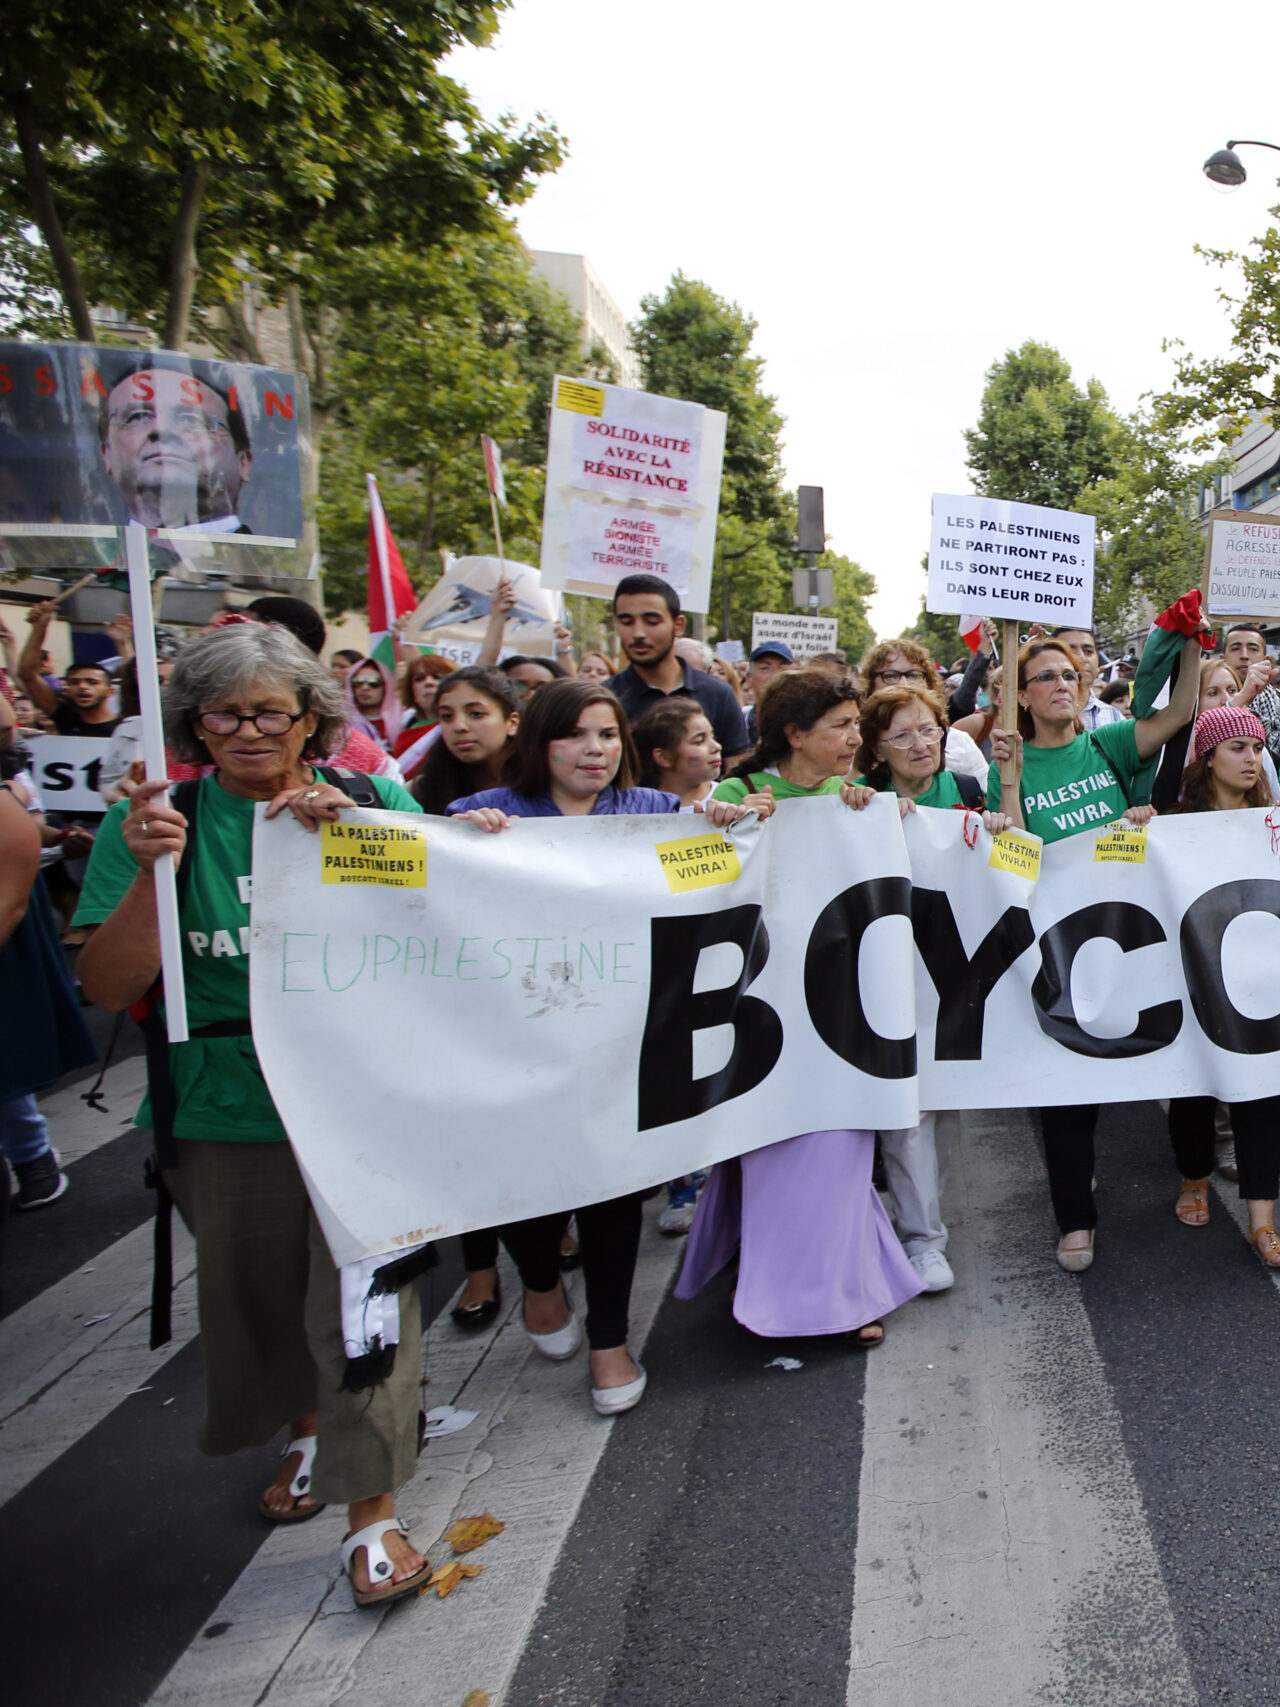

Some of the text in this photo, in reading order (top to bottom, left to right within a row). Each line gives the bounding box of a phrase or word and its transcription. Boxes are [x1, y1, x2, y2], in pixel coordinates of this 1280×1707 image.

[587, 421, 691, 454] SOLIDARITÉ
[604, 446, 672, 469] AVEC LA
[583, 459, 688, 492] RÉSISTANCE
[610, 517, 656, 533] ARMÉE
[946, 516, 1081, 545] LES PALESTINIENS
[1226, 524, 1238, 536] Je
[604, 529, 661, 547] SIONISTE
[608, 543, 654, 558] ARMÉE
[940, 538, 960, 550] NE
[966, 541, 1048, 561] PARTIRONT
[1052, 553, 1077, 566] PAS
[592, 552, 669, 573] TERRORISTE
[940, 560, 1084, 588] ILS SONT CHEZ EUX
[1227, 566, 1257, 578] PEUPLE
[946, 582, 1077, 608] DANS LEUR DROIT
[1211, 582, 1267, 599] DISSOLUTION
[1269, 591, 1279, 599] de
[755, 616, 768, 625] Le
[772, 619, 809, 628] monde
[757, 630, 788, 639] assez
[806, 643, 829, 652] folie
[1024, 769, 1117, 814] PALESTINE
[1053, 801, 1114, 831] VIVRA
[330, 825, 417, 841] LA PALESTINE
[361, 844, 385, 856] AUX
[660, 842, 733, 865] PALESTINE
[993, 836, 1040, 860] PALESTINE
[1096, 843, 1139, 853] PALESTINIENS
[325, 856, 423, 872] PALESTINIENS !
[340, 875, 377, 883] BOYCOTT
